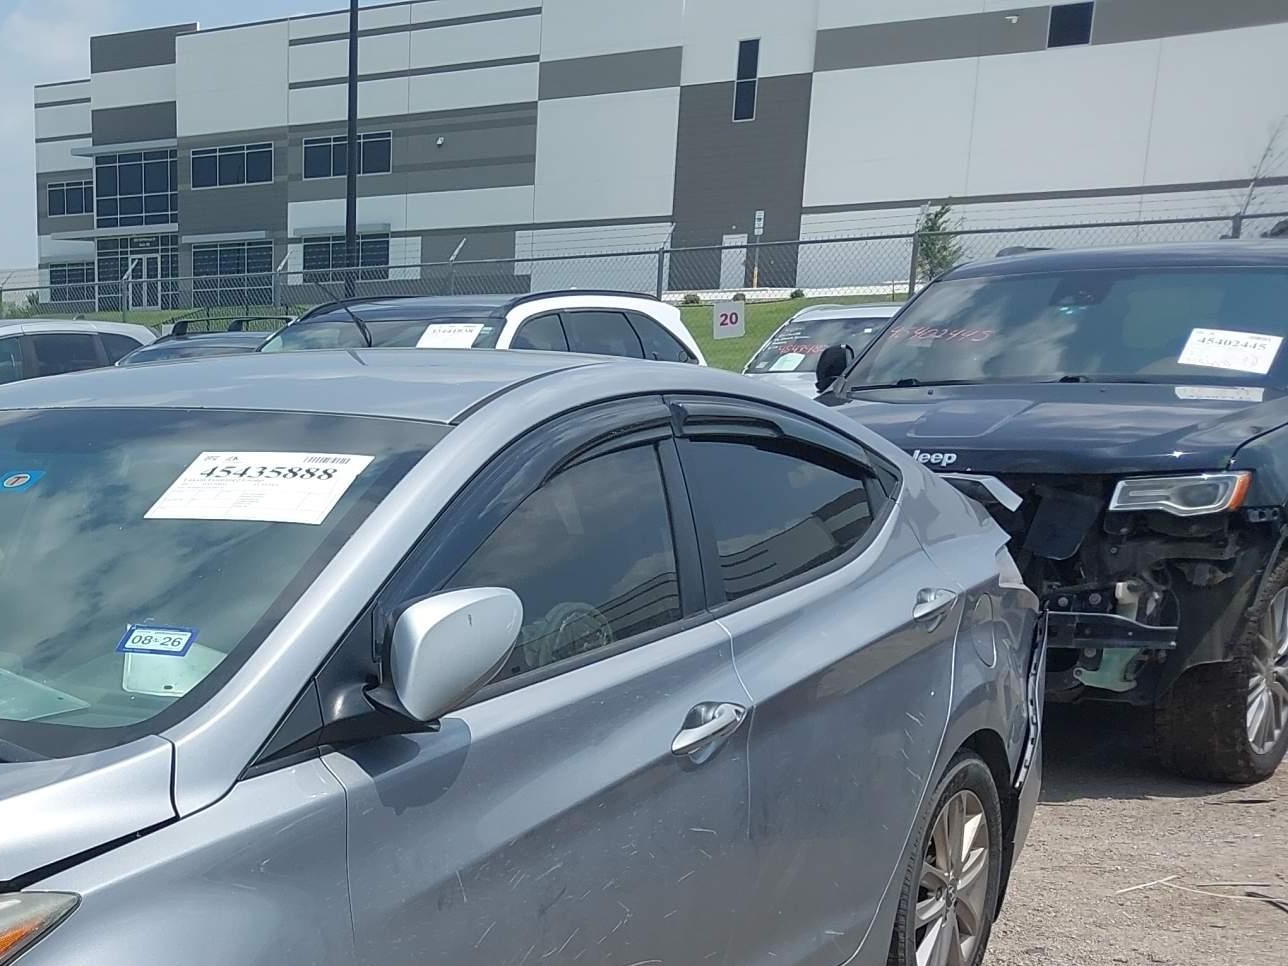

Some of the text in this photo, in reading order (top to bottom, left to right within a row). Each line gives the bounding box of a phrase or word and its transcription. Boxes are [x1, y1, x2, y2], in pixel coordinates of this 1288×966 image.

[719, 312, 739, 326] 20
[913, 449, 957, 467] Jeep
[199, 465, 337, 481] 45435888
[131, 634, 183, 647] 08 26
